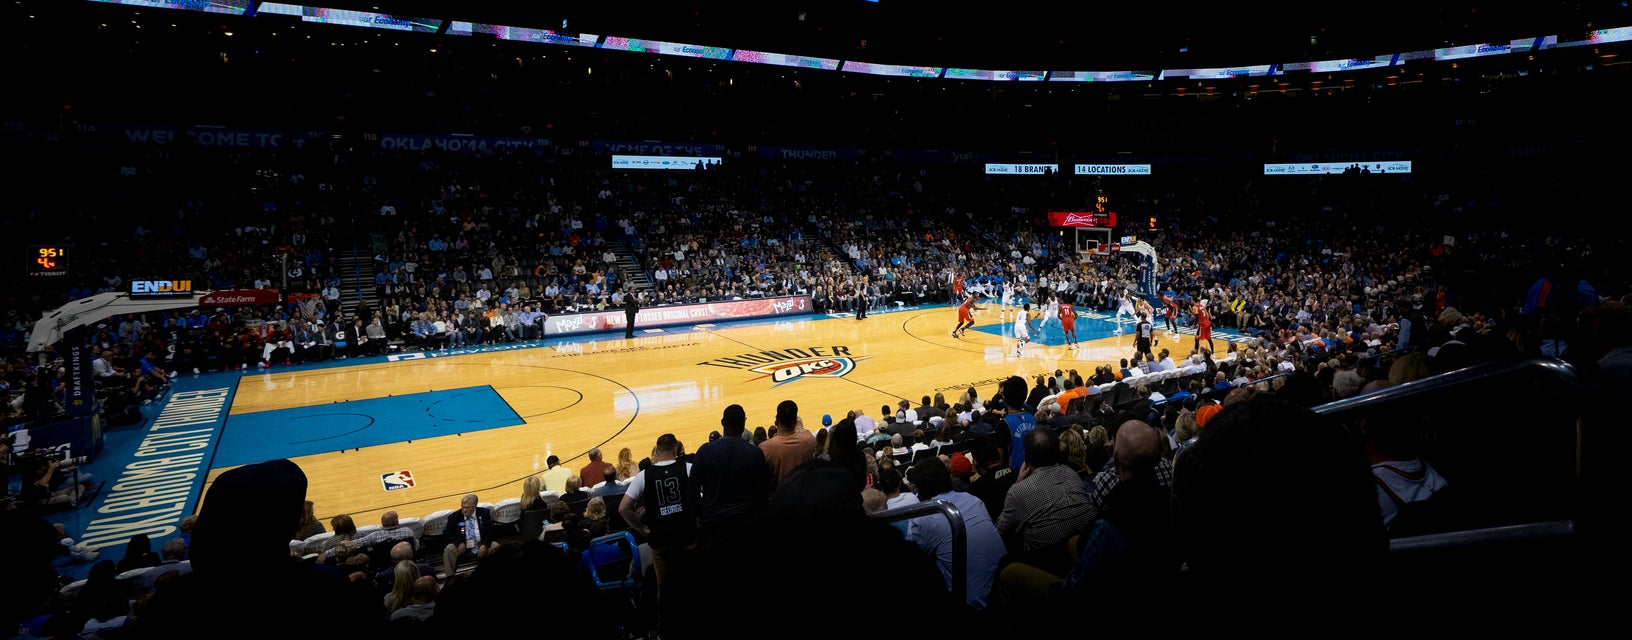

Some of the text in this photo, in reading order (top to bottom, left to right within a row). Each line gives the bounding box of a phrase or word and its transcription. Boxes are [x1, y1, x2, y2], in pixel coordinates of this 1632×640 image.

[374, 15, 412, 27] Economy
[380, 136, 487, 152] OKLAHOMA
[780, 148, 837, 160] THUNDER
[1014, 165, 1023, 173] 18
[1088, 165, 1126, 173] LOCATIONS
[131, 279, 192, 292] ENDUI
[690, 308, 708, 318] CRUST
[335, 331, 345, 340] G
[696, 345, 852, 369] THUNDER
[71, 345, 82, 397] DRAFTKINGS
[772, 358, 835, 383] OKC
[74, 386, 231, 554] OKLAHOMA CITY THUNDER
[655, 476, 682, 506] 13
[659, 503, 684, 516] GEORGE
